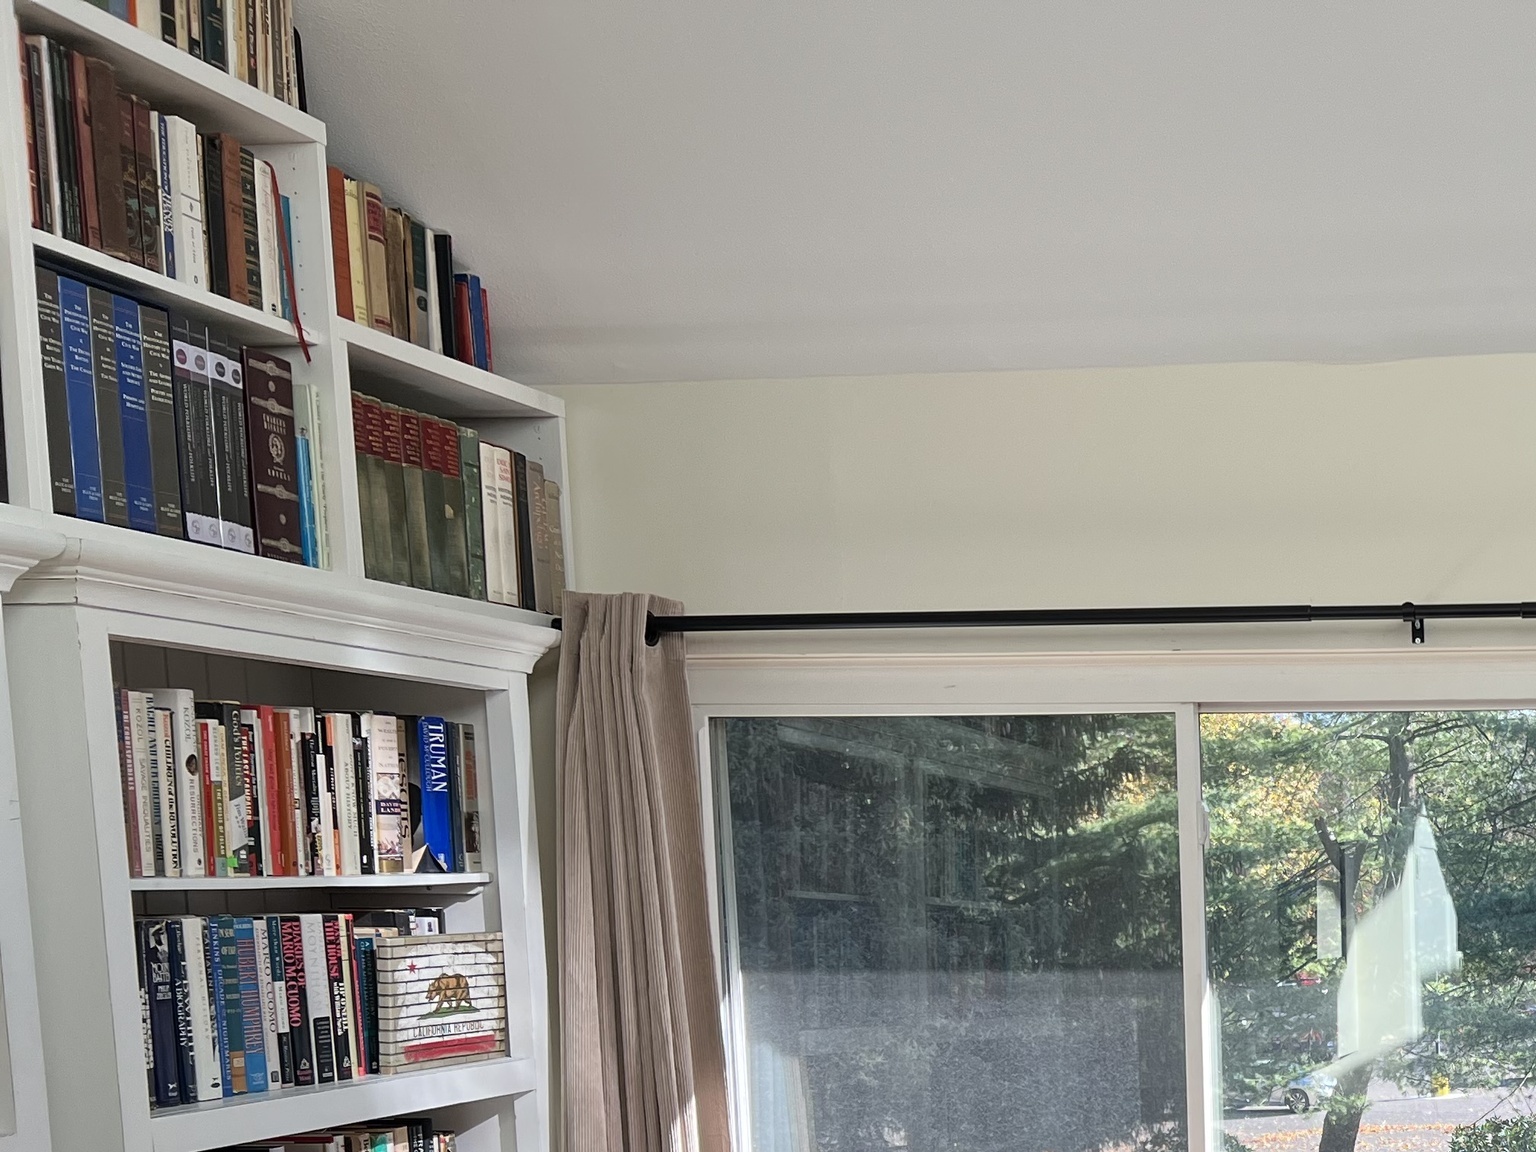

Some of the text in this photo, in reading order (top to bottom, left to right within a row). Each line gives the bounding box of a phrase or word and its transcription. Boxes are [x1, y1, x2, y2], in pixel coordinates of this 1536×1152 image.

[135, 708, 143, 742] KOZOL
[183, 707, 191, 742] KOZOL
[232, 711, 244, 786] God's Politics
[429, 723, 448, 792] TRUMAN
[139, 758, 151, 852] SAVAGE INEQUALITIES
[189, 779, 198, 853] RESURRECTIONS
[218, 826, 224, 834] OF
[210, 923, 220, 962] JENKINS
[281, 922, 301, 1027] MARIO M. CUOMO
[237, 939, 264, 1055] HUBERT HUMPHREY
[413, 1021, 484, 1038] CALIFORNIA REPUBLIC
